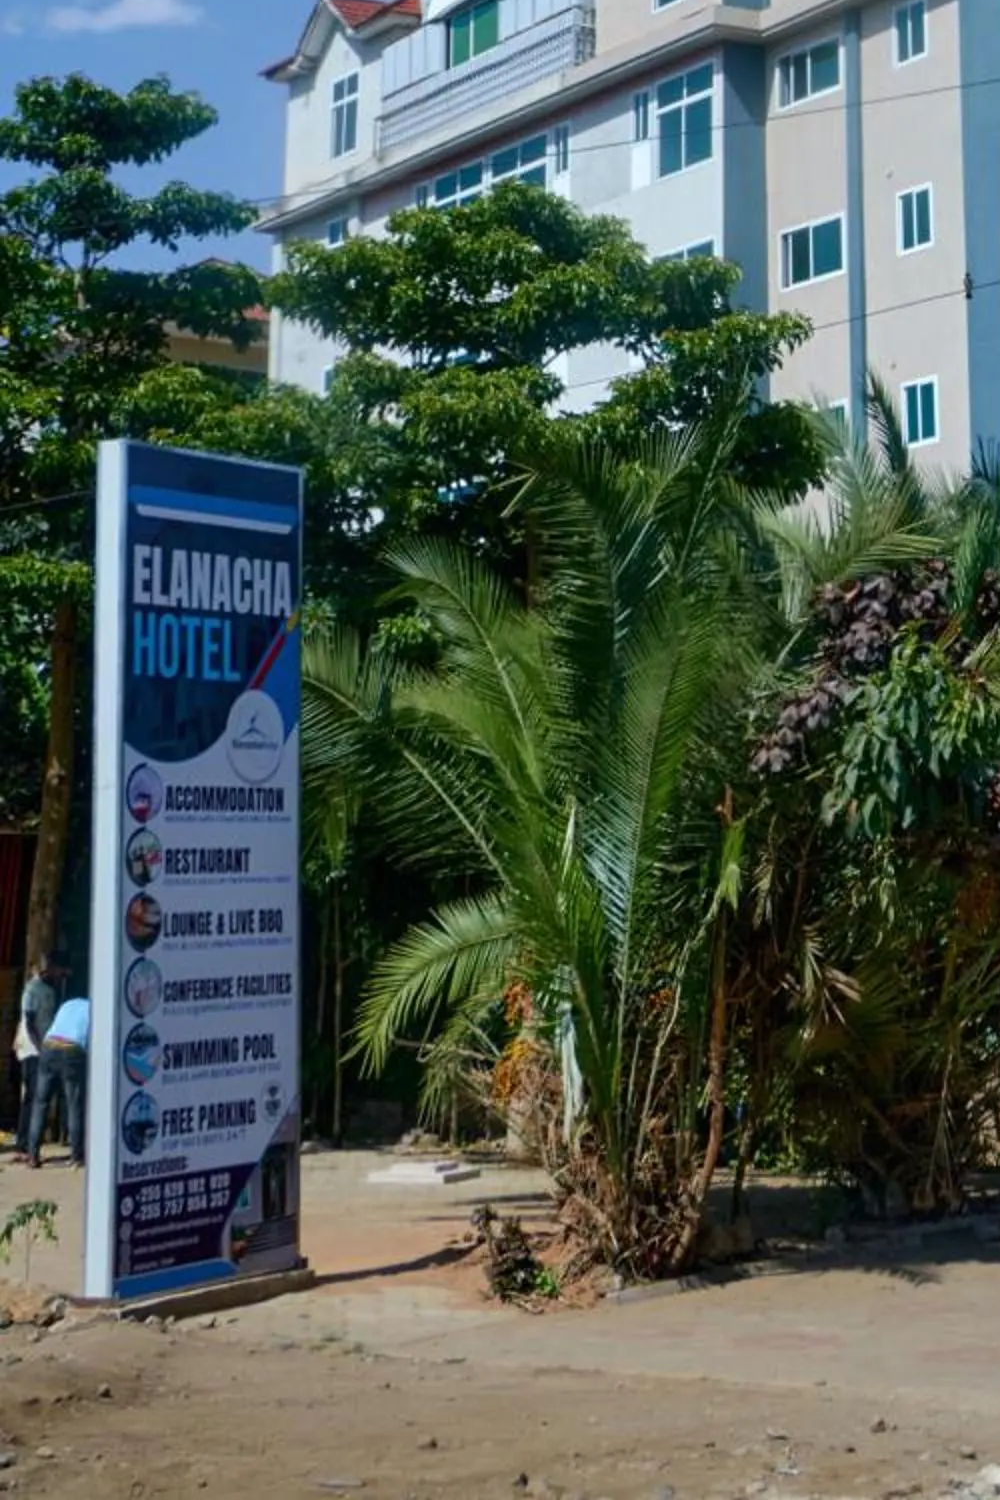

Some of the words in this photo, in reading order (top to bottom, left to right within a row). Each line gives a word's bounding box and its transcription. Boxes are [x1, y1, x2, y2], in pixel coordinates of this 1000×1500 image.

[132, 544, 292, 617] ELANACHA
[132, 610, 242, 682] HOTEL
[165, 785, 285, 812] ACCOMMODATION
[164, 847, 251, 875] RESTAURANT
[163, 912, 213, 938] LOUNGE
[215, 914, 225, 936] &
[228, 911, 255, 935] LIVE
[163, 978, 234, 1003] CONFERENCE
[236, 974, 292, 997] FACILITIES
[162, 1039, 240, 1070] SWIMMING
[242, 1035, 277, 1061] POOL
[162, 1108, 195, 1138] FREE
[198, 1099, 257, 1131] PARKING
